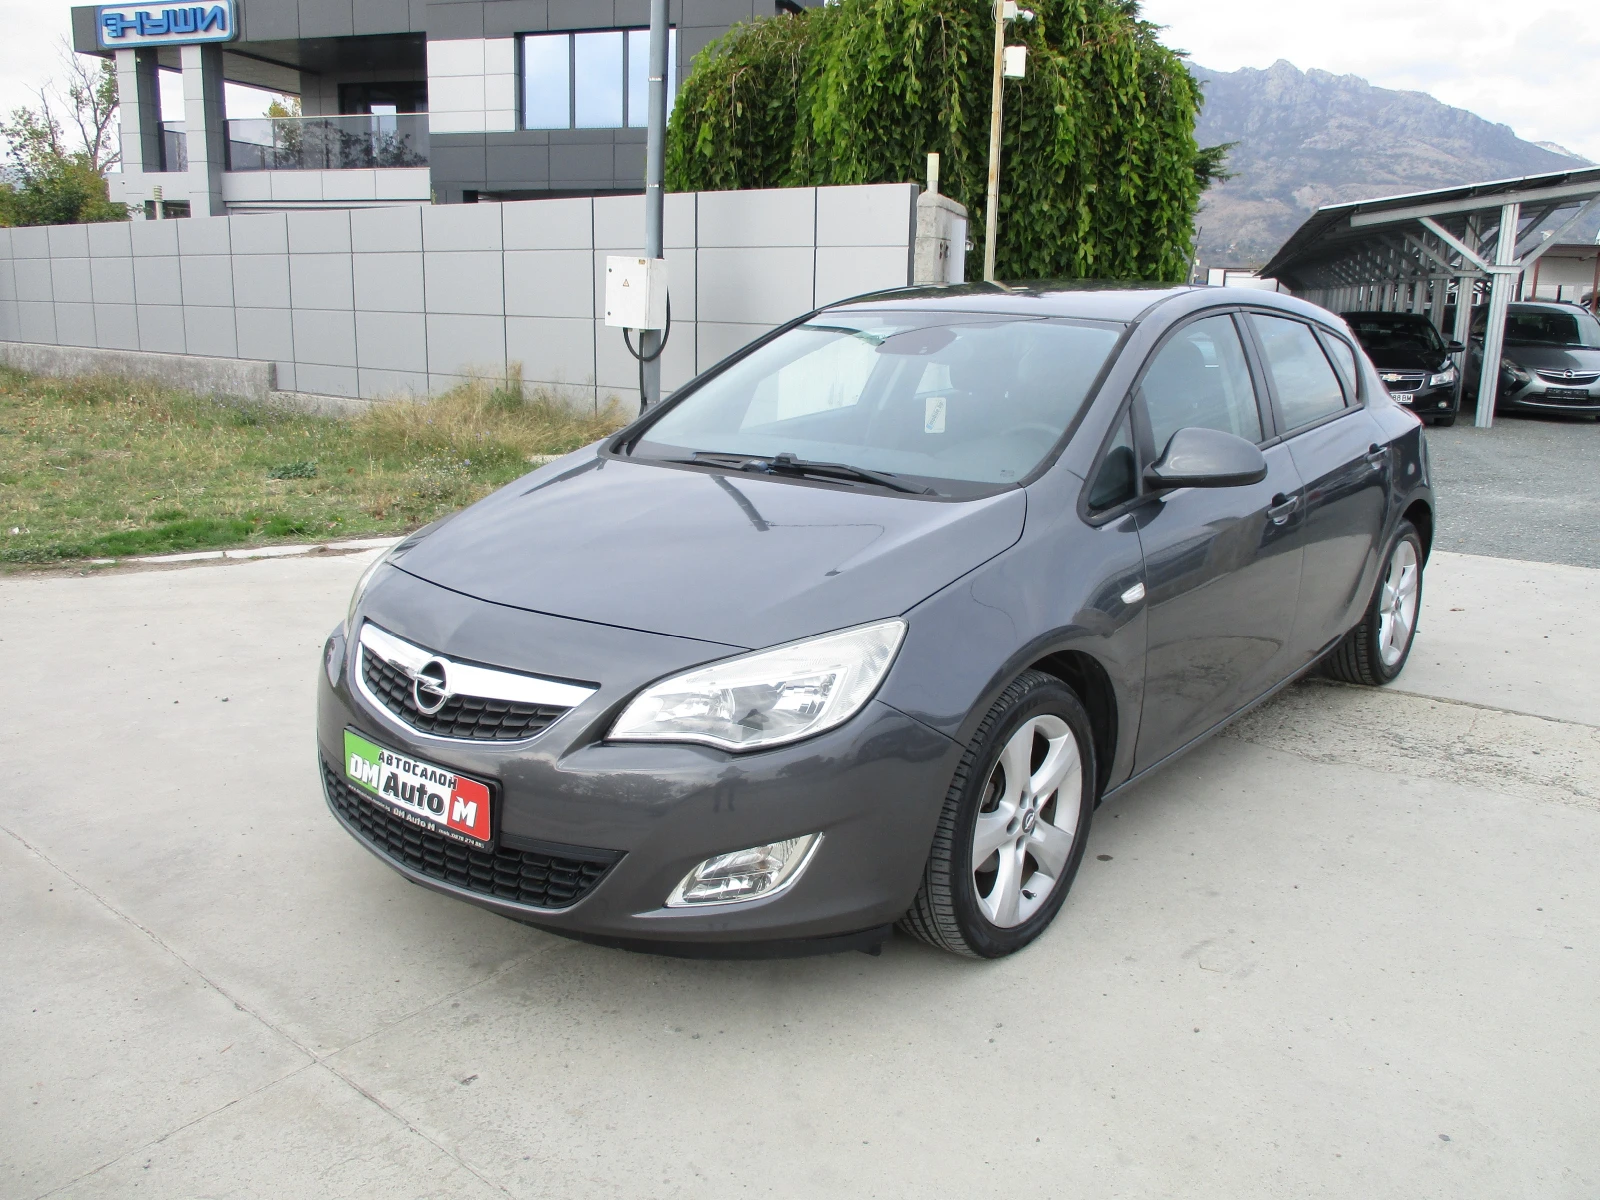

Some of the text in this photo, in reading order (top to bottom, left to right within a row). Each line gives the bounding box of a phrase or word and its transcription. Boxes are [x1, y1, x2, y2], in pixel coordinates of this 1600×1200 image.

[378, 750, 458, 790] АВТОСАЛОН
[350, 752, 380, 790] DM
[383, 771, 445, 815] Auto
[452, 796, 478, 829] M
[393, 807, 405, 819] DM
[406, 813, 426, 827] Auto
[427, 823, 436, 832] M
